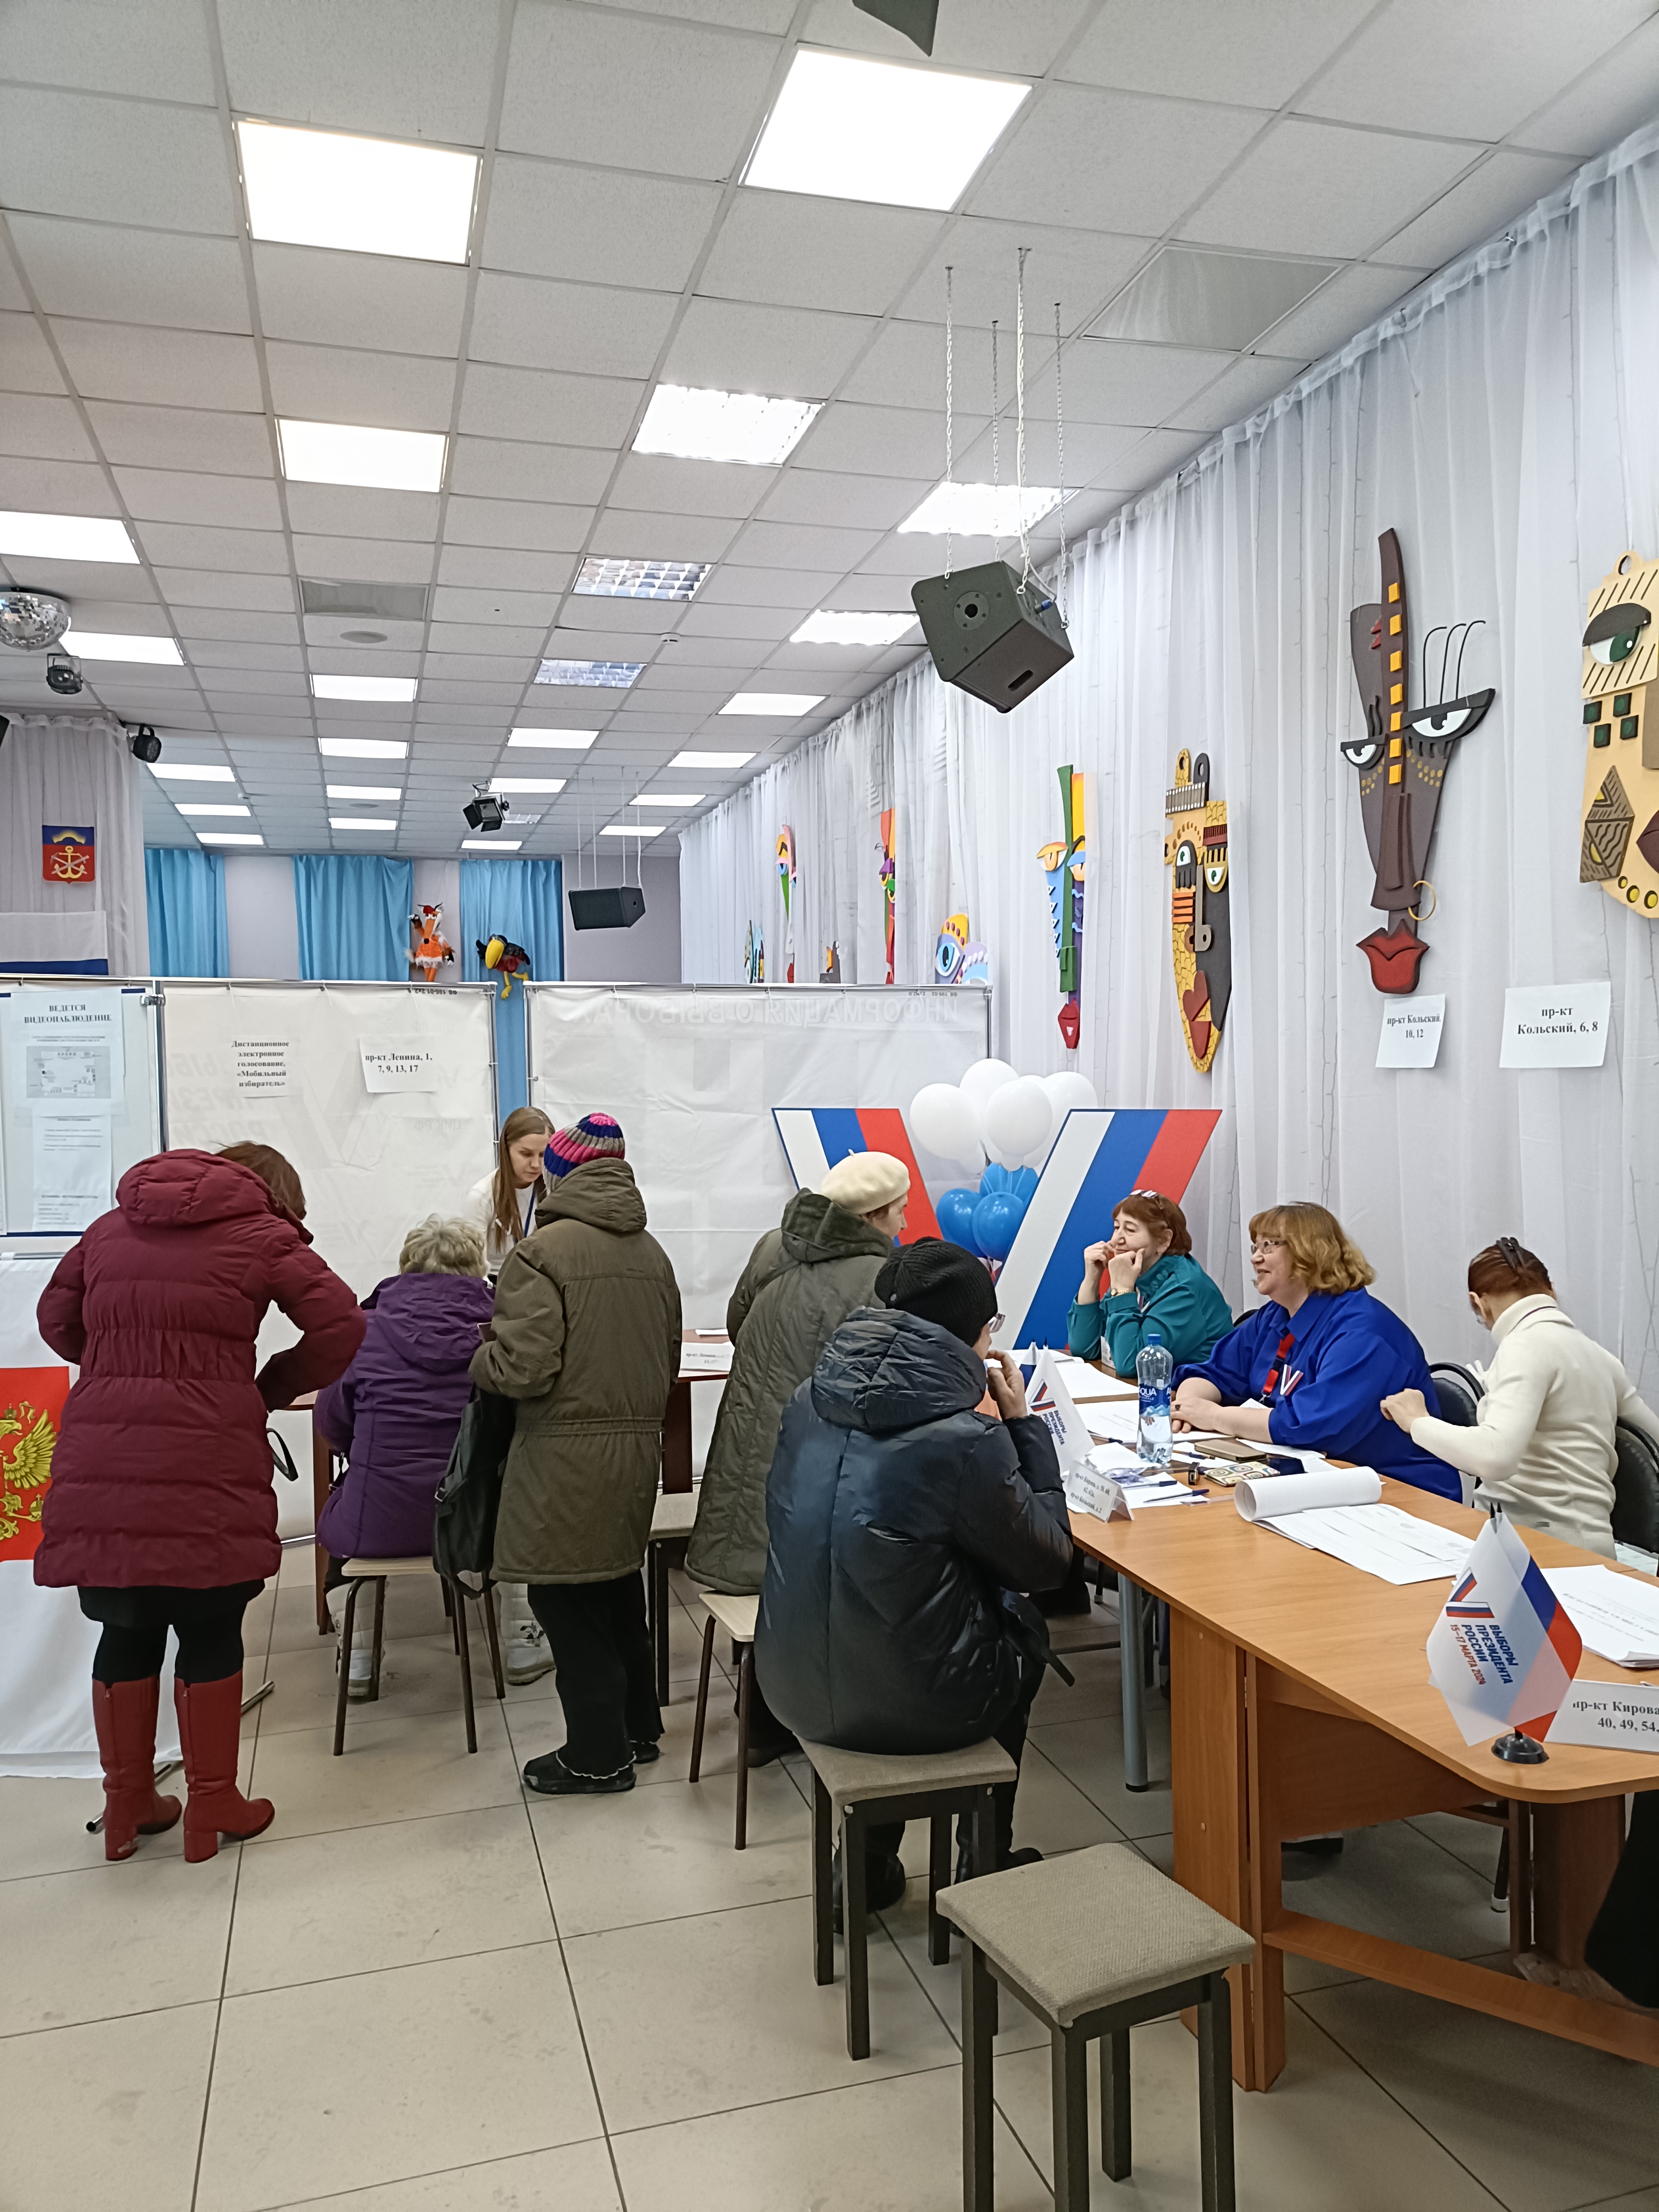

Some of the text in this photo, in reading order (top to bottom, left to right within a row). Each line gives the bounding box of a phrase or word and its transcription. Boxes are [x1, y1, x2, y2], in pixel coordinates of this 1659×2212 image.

[49, 1004, 86, 1012] ВЕДЕТСЯ
[1542, 1007, 1573, 1019] пр-кт
[24, 1014, 112, 1024] ВИДЕОНАБЛЮДЕНИЕ
[1387, 1018, 1405, 1027] пр-кт
[1405, 1029, 1423, 1040] 10, 12
[1517, 1021, 1598, 1035] Кольский, 6, 8
[388, 1053, 423, 1061] Ленина,
[426, 1053, 432, 1061] 1,
[378, 1065, 385, 1074] 7,
[386, 1065, 393, 1073] 9,
[396, 1065, 407, 1074] 13,
[239, 1080, 286, 1088] избиратель»
[1054, 1410, 1067, 1433] ВЫБОРЫ
[1048, 1412, 1065, 1445] ПРЕЗИДЕНТА
[1461, 1625, 1489, 1662] РОССИИ
[1489, 1625, 1519, 1666] ВЫБОРЫ
[1475, 1625, 1514, 1684] ПРЕЗИДЕНТА
[1459, 1644, 1478, 1668] МАРТА
[1471, 1669, 1486, 1685] 2024
[1597, 1717, 1659, 1734] 40, 49, 54,
